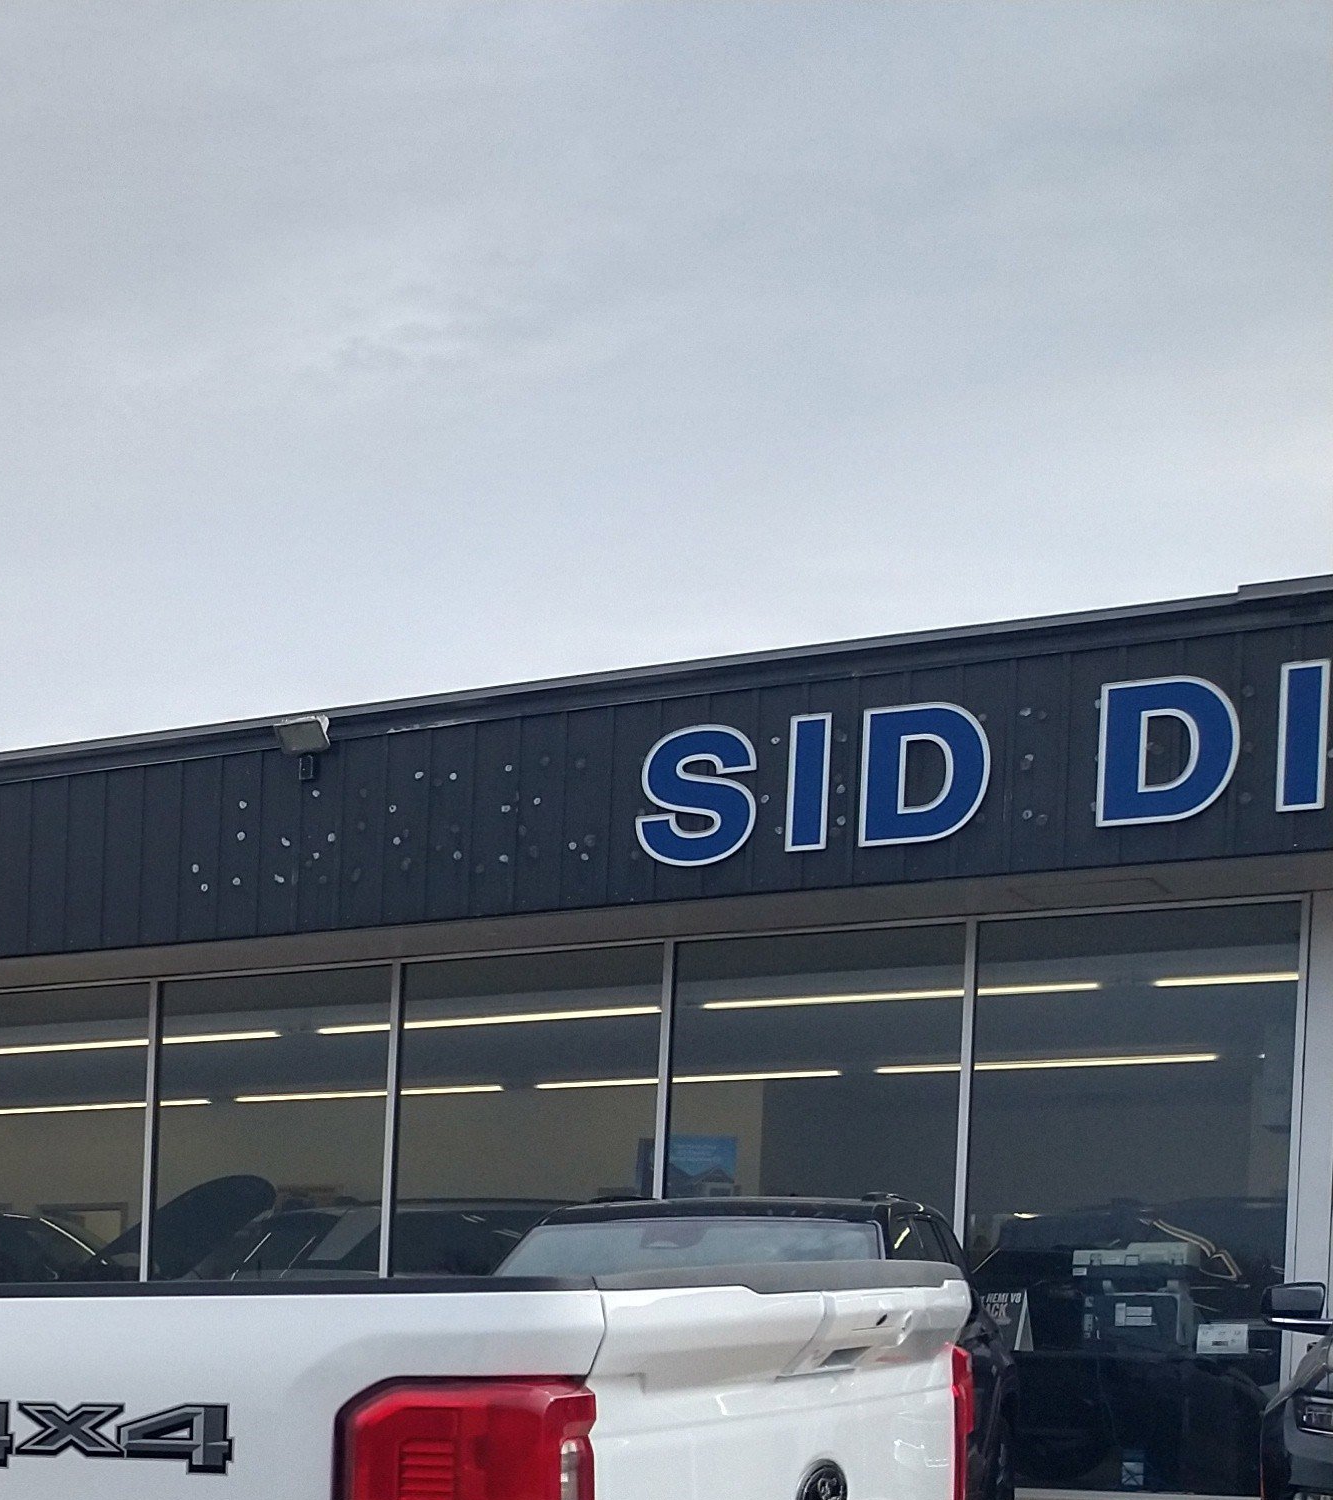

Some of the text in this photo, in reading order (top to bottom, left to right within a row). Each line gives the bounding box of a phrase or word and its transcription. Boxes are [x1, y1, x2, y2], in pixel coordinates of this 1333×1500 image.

[635, 658, 1331, 867] SID DI
[1010, 1292, 1022, 1304] V8
